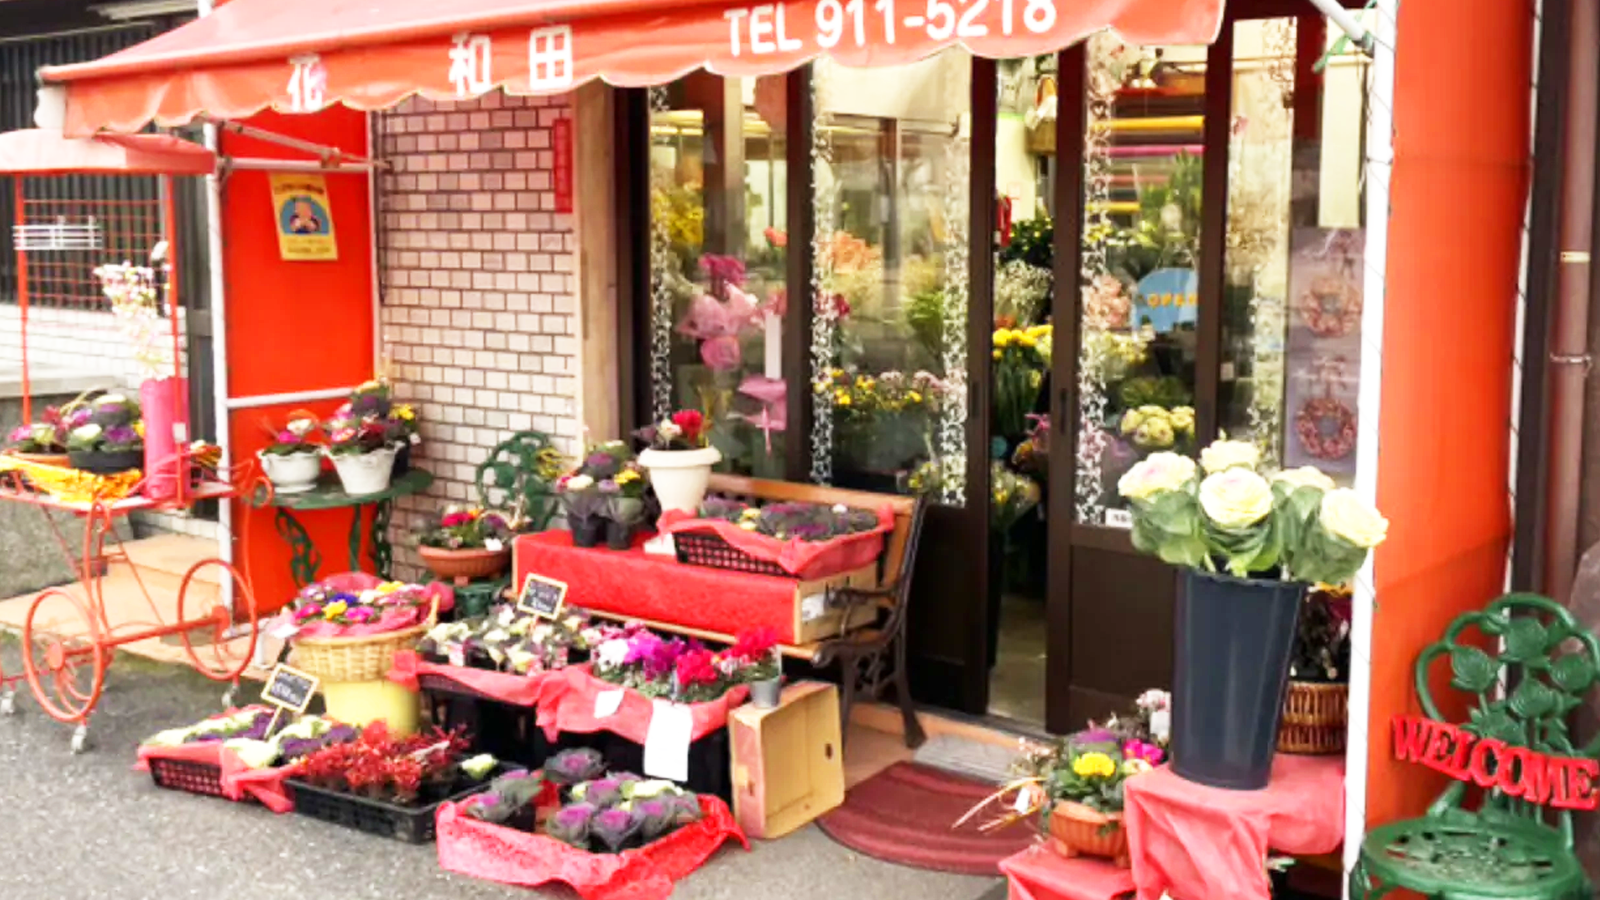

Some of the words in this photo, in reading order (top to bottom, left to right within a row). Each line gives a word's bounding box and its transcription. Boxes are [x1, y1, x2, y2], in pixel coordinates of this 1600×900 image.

[724, 5, 802, 56] TEL
[815, 0, 1056, 48] 911-5218
[1392, 714, 1599, 809] WELCOME
